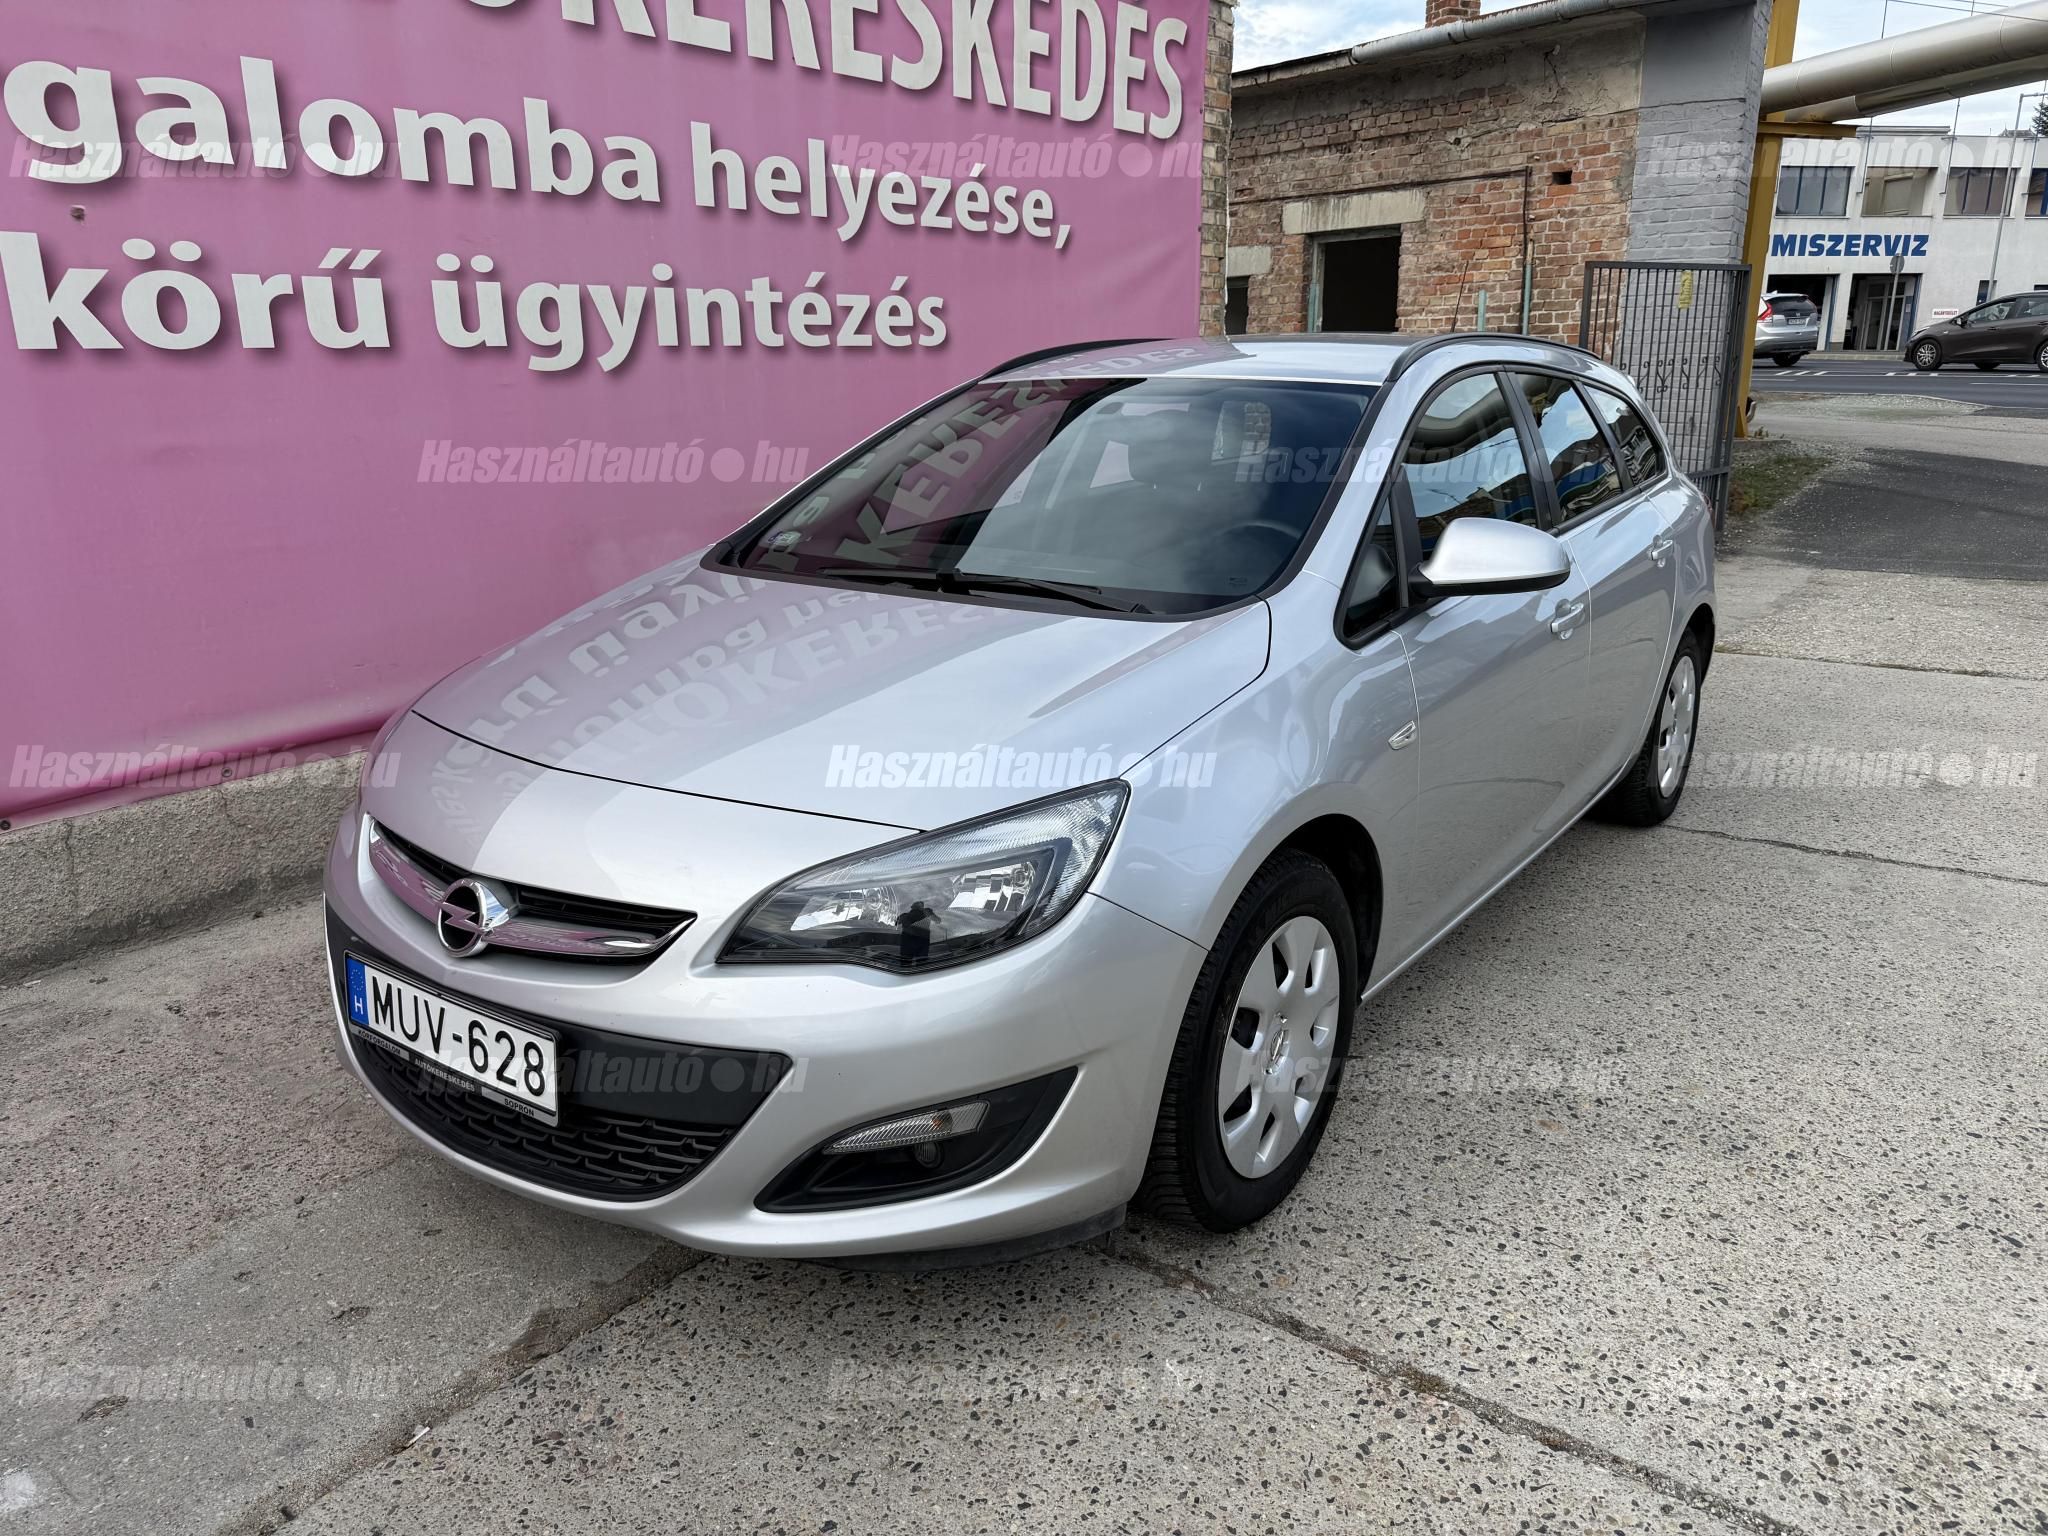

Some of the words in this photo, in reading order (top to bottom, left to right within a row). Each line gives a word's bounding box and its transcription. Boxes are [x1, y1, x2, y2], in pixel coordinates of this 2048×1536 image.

[3, 56, 660, 202] galomba
[690, 121, 1072, 249] helyezése,
[0, 231, 391, 349] körű
[431, 253, 948, 372] ügyintézés
[1768, 233, 1930, 257] MISZERVIZ
[354, 996, 364, 1015] H
[372, 976, 546, 1097] MUV-628
[504, 1098, 535, 1117] SOPRON
